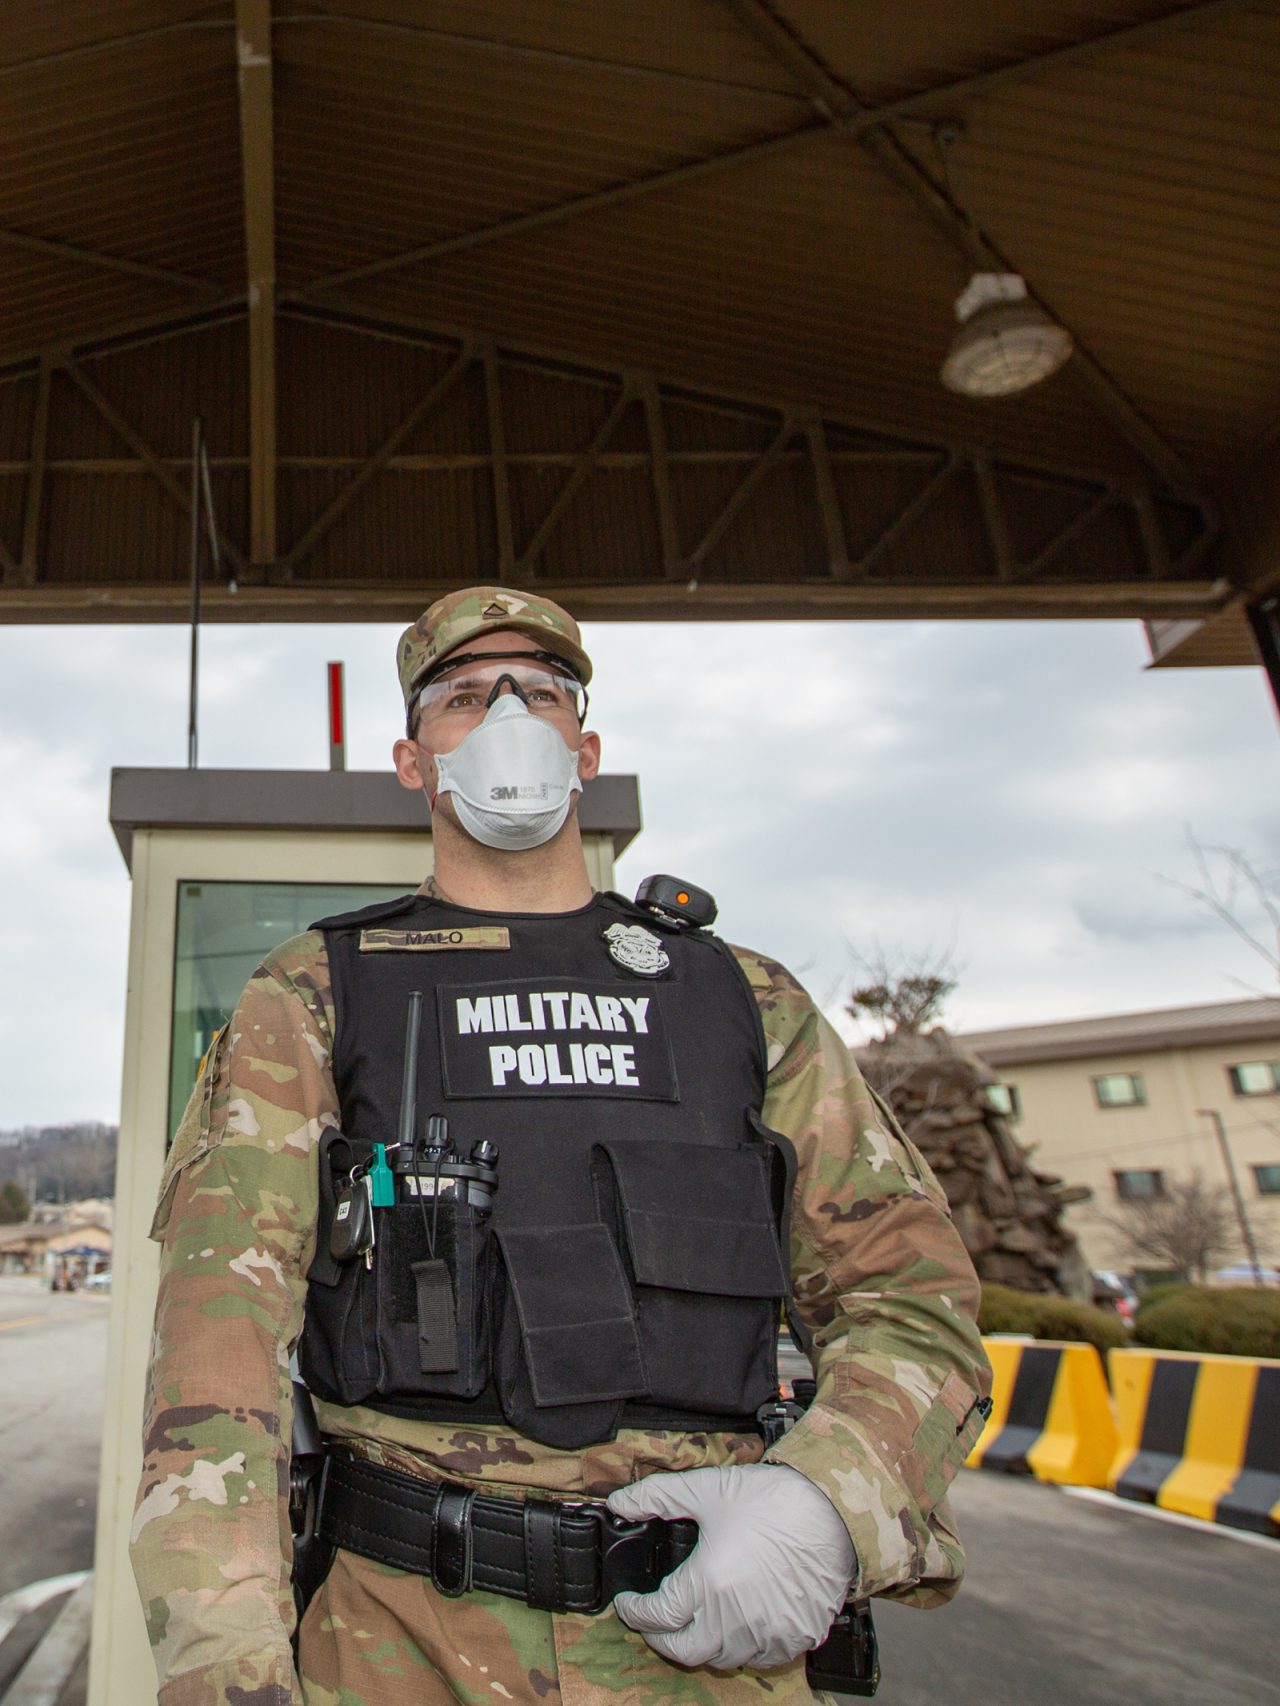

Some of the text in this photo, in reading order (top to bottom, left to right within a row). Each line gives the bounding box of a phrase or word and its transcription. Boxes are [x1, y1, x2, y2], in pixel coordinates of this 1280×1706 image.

[490, 787, 518, 800] 3M
[405, 931, 463, 945] MALO
[456, 992, 650, 1034] MILITARY
[489, 1043, 640, 1086] POLICE
